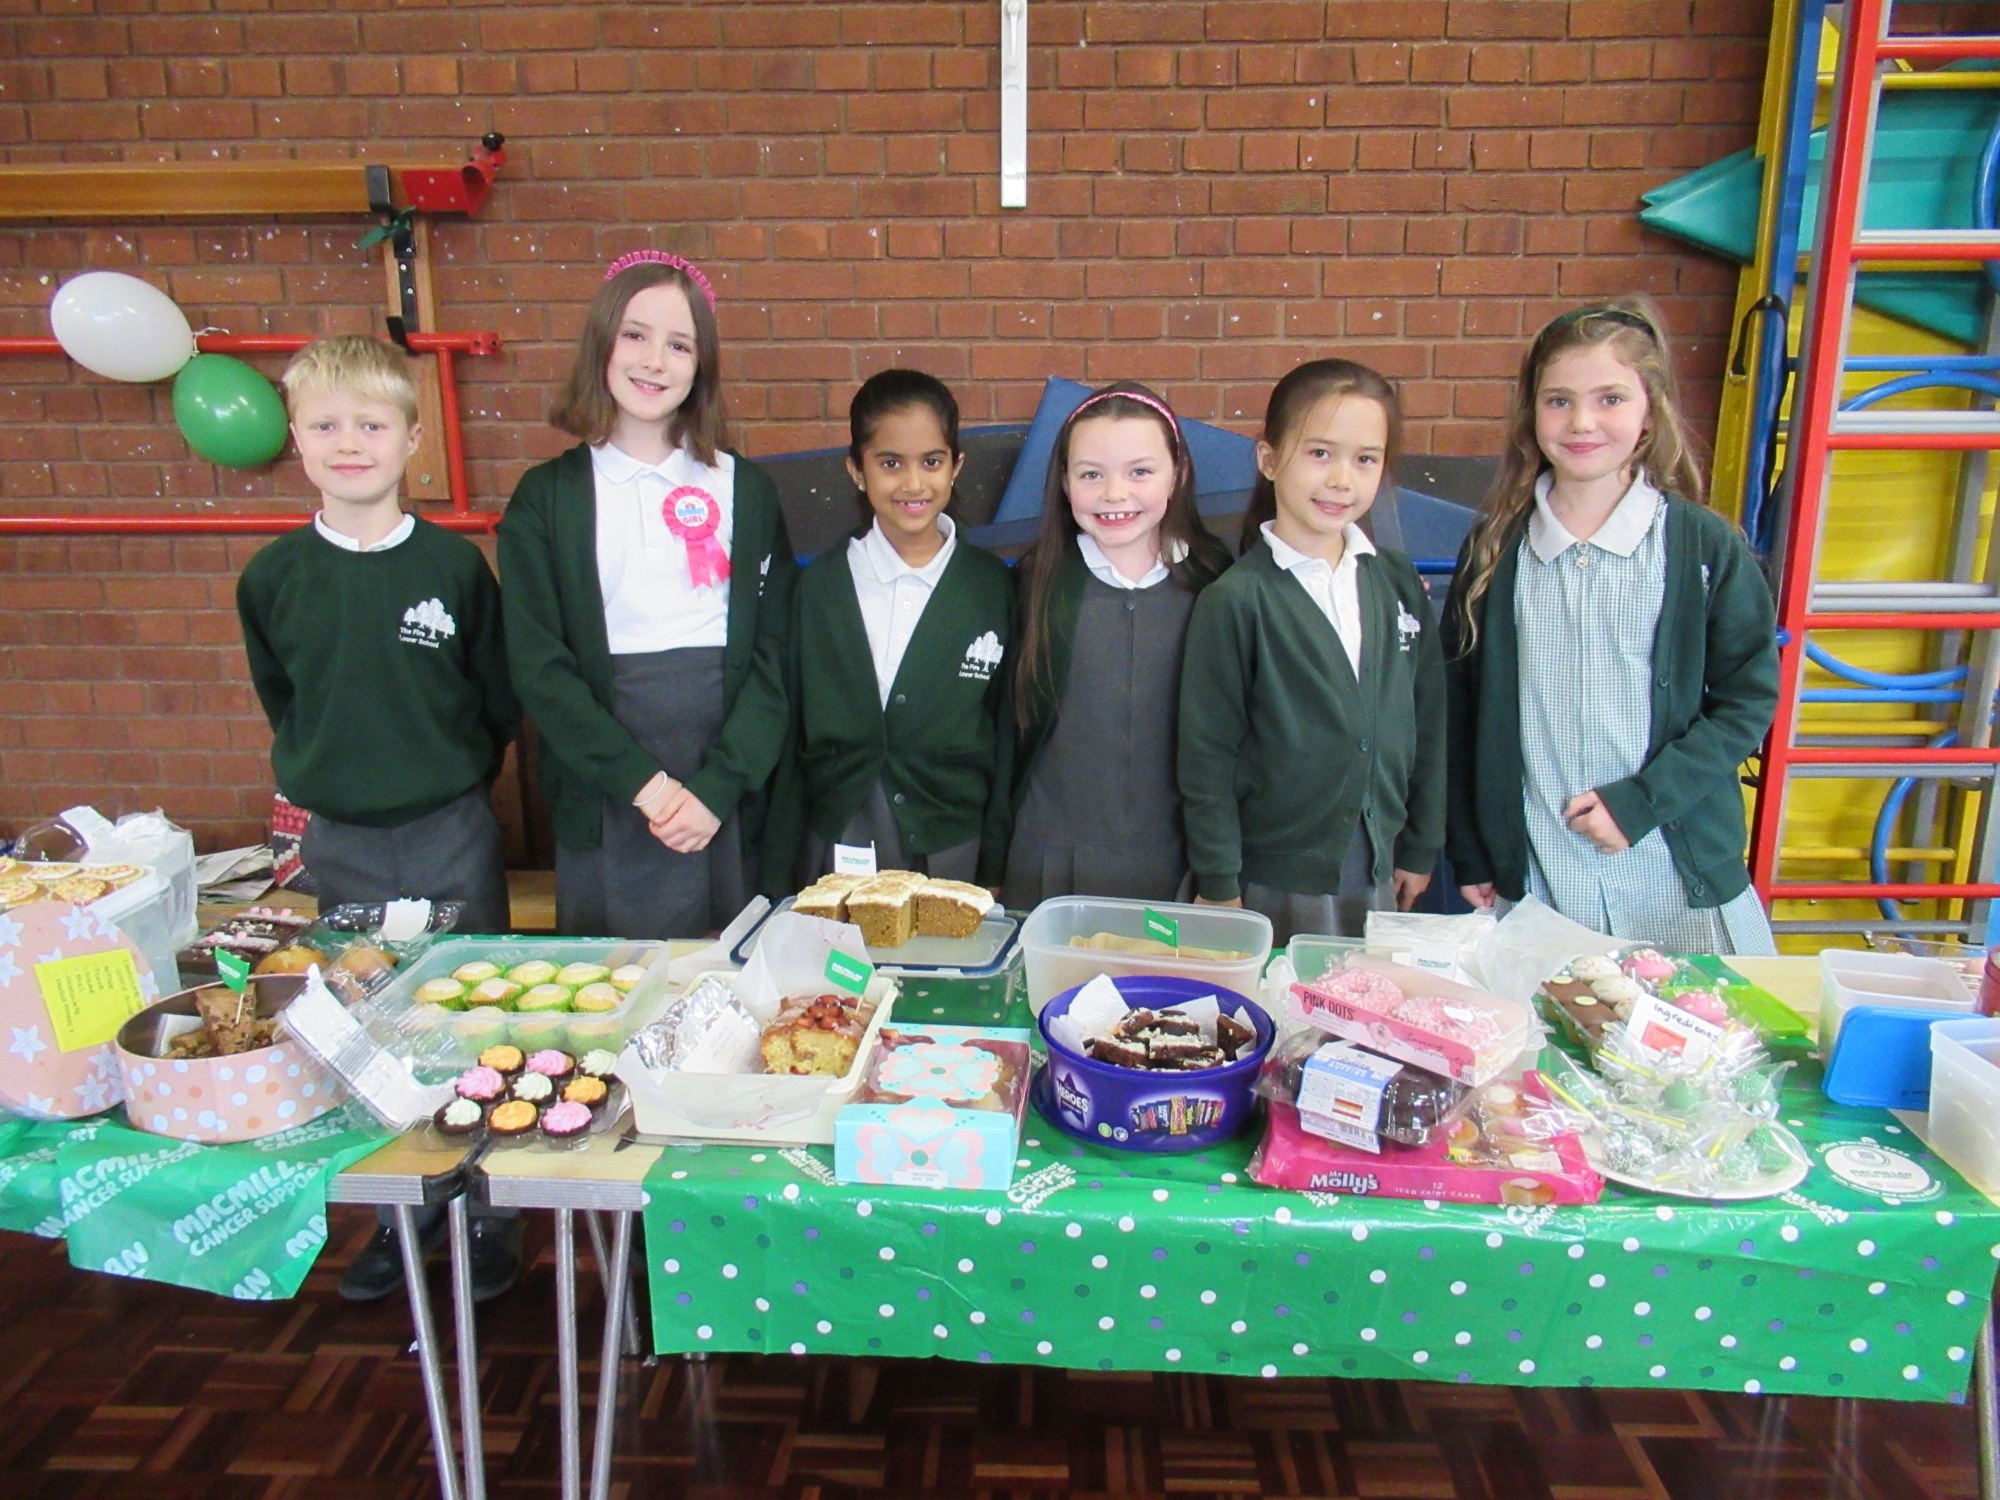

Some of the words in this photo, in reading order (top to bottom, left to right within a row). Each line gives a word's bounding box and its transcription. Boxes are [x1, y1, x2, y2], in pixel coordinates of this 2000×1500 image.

[682, 514, 703, 524] GIRL
[399, 634, 418, 643] Lower
[418, 638, 439, 649] School
[400, 626, 412, 635] The
[974, 672, 990, 680] School
[1303, 991, 1325, 1011] PINK
[1328, 1001, 1354, 1021] DOTS
[1654, 1003, 1718, 1042] Ingredients
[1058, 1082, 1088, 1113] HEROES
[1007, 1164, 1077, 1203] COFFEE
[1022, 1175, 1076, 1215] MORNING
[1310, 1173, 1379, 1195] Molly's
[1395, 1187, 1417, 1196] ICED
[1450, 1191, 1482, 1200] CAKES
[1432, 1182, 1443, 1190] 12
[63, 1180, 122, 1228] ANCER
[190, 1208, 259, 1256] CANCER
[254, 1166, 320, 1215] SUPPOR
